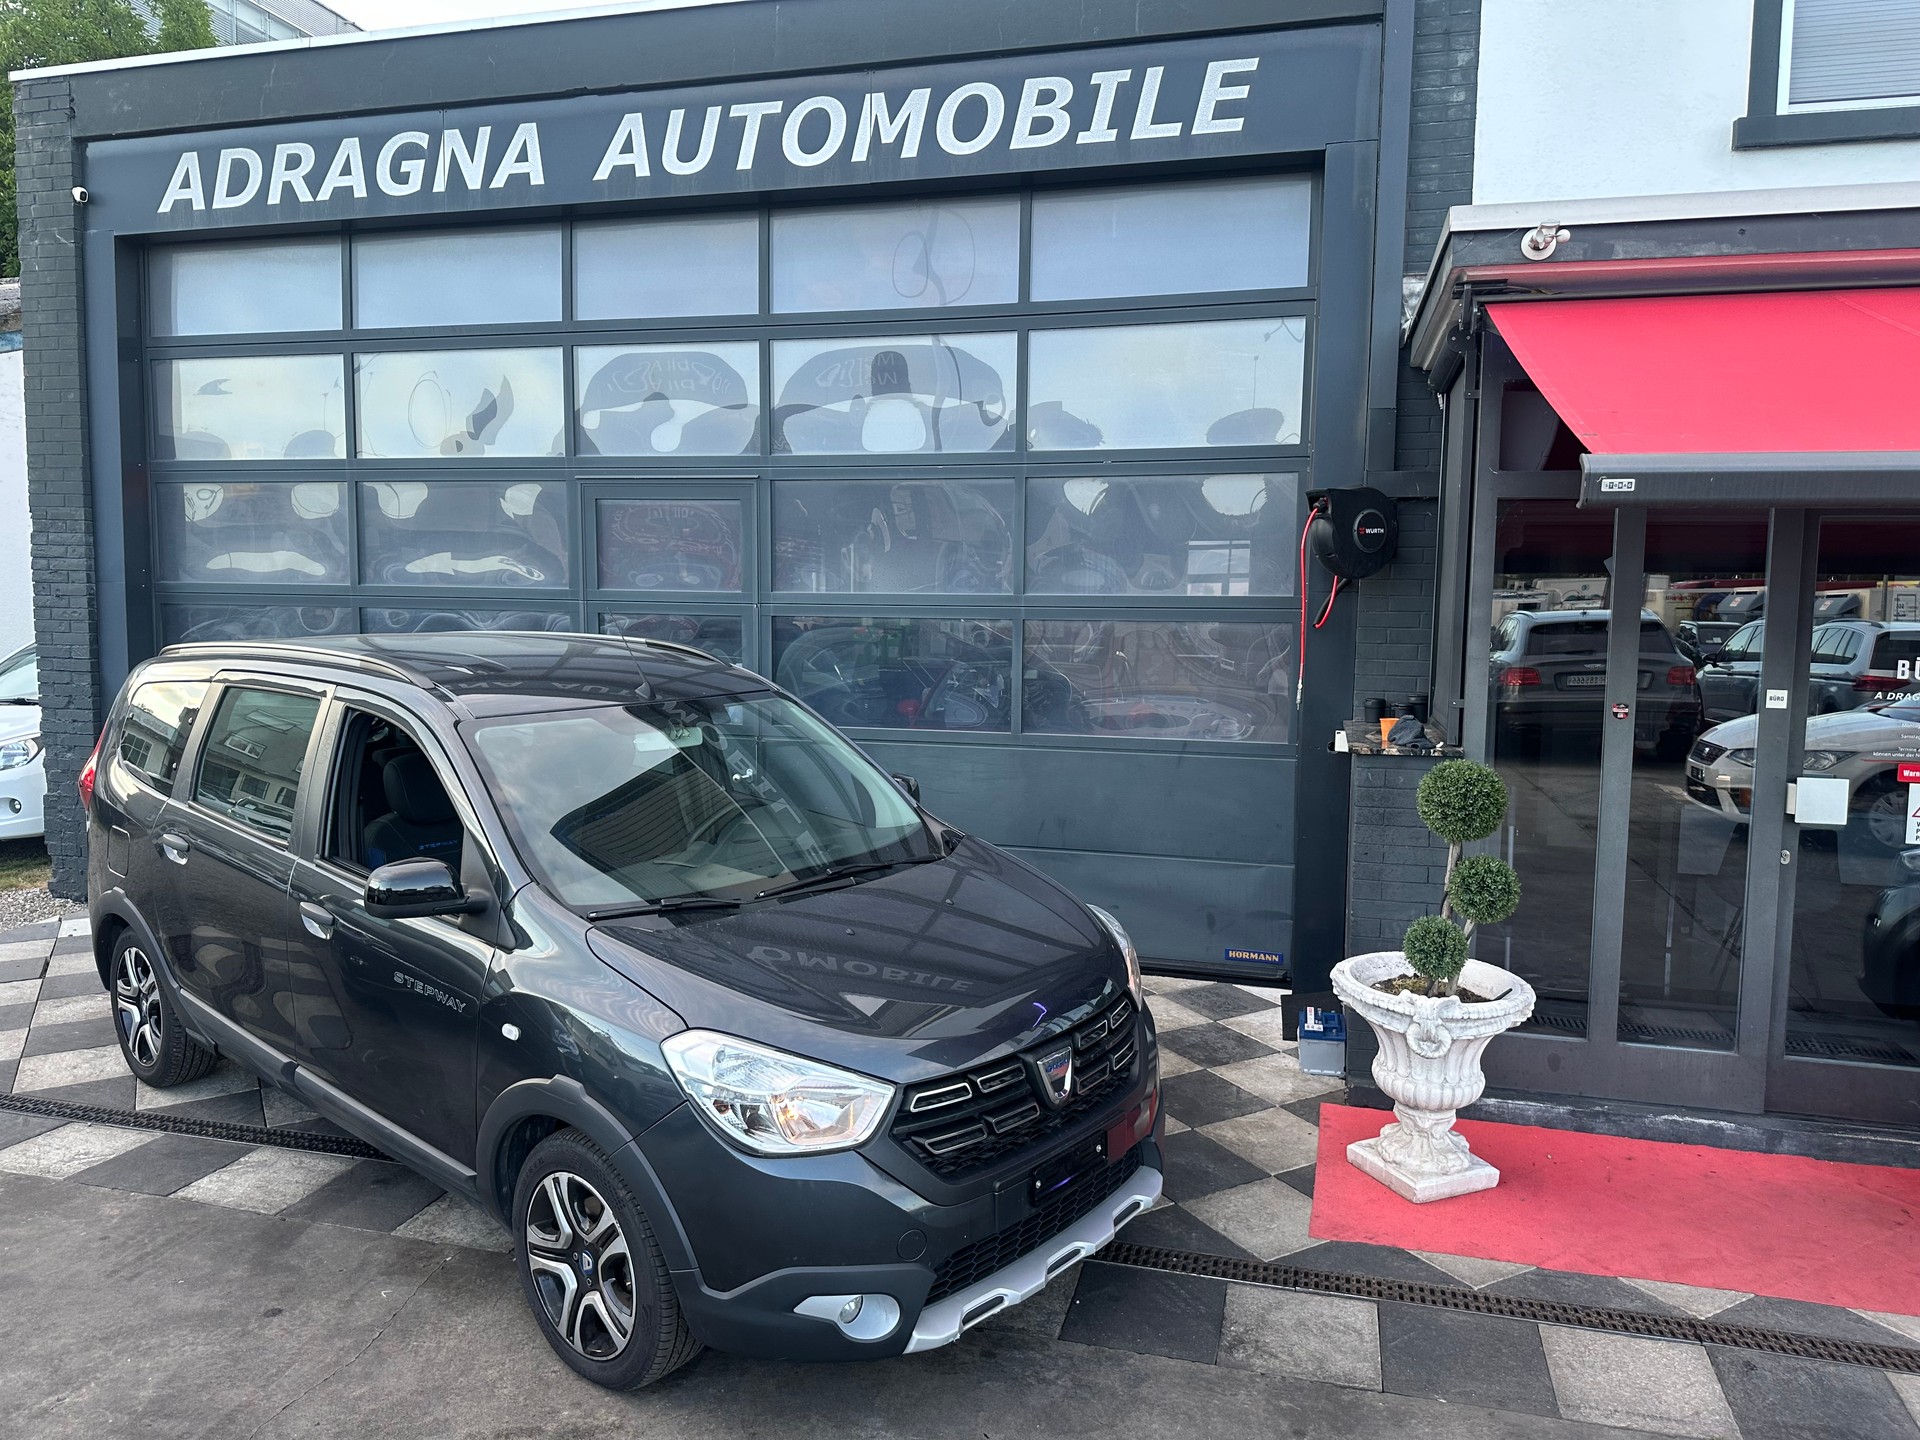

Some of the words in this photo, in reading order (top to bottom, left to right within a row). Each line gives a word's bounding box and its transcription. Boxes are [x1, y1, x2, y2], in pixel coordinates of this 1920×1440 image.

[157, 122, 545, 214] ADRAGNA
[593, 57, 1260, 182] AUTOMOBILE
[418, 839, 458, 850] STEPWAY
[393, 971, 467, 1013] STEPWAY
